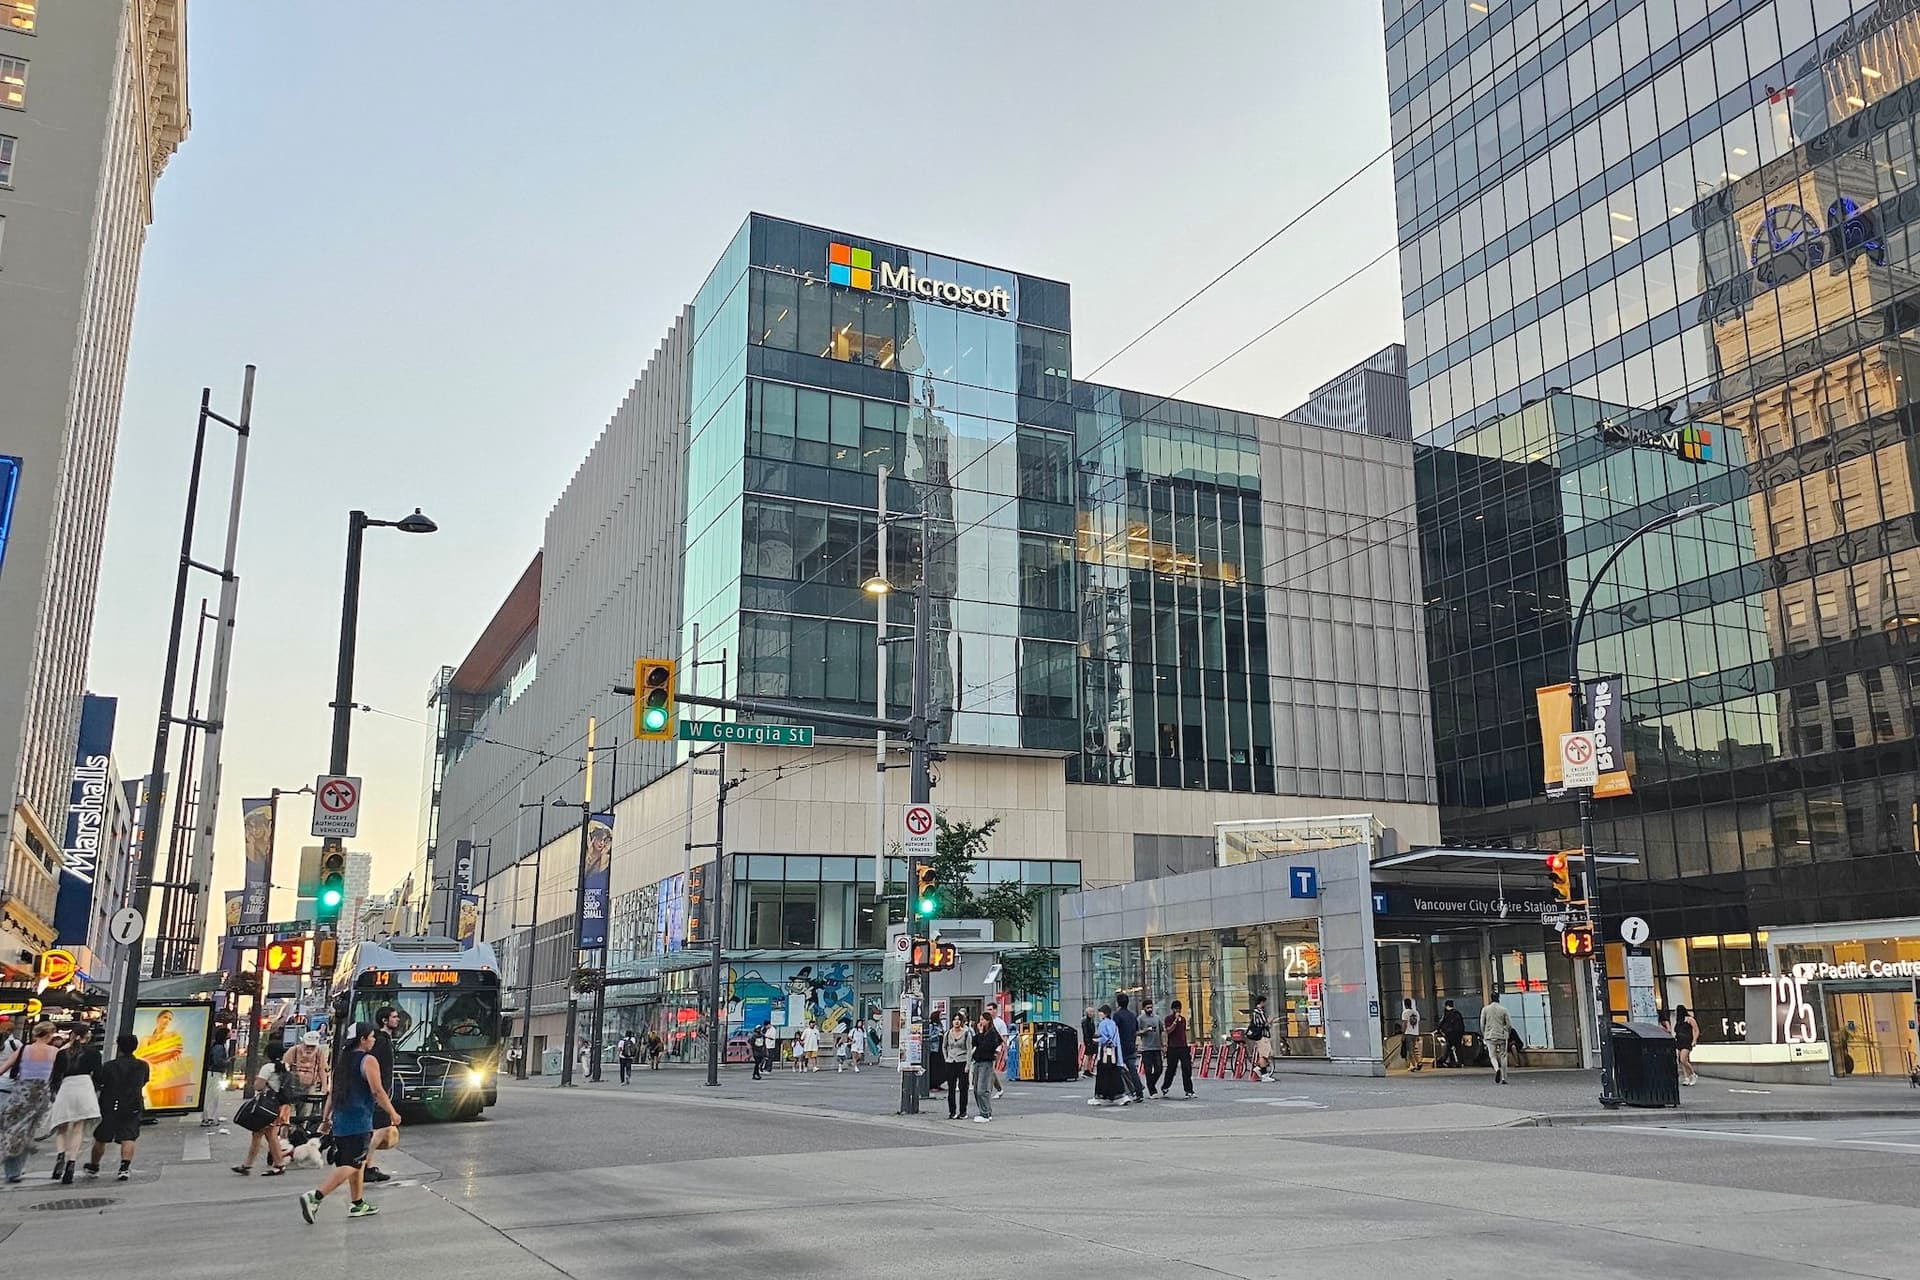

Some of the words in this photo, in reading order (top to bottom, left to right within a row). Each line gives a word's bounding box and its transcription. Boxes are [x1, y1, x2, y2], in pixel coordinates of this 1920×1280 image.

[880, 261, 1010, 313] Microsoft
[690, 722, 703, 737] W
[713, 724, 780, 743] Georgia
[789, 728, 805, 742] St
[62, 755, 109, 884] Marshalls
[1296, 872, 1311, 893] T
[583, 901, 600, 910] SHOP
[1373, 895, 1384, 911] T
[1414, 898, 1467, 912] Vancouver
[1469, 899, 1488, 914] City
[1490, 899, 1522, 912] Cetre
[1524, 899, 1558, 912] Station
[583, 910, 604, 919] SMALL
[232, 926, 241, 935] W
[244, 924, 280, 935] Georgia
[1584, 934, 1592, 952] 3
[291, 946, 302, 967] 3
[946, 948, 954, 966] 3
[375, 971, 390, 985] 14
[411, 971, 459, 984] DOWNTOWN
[1819, 961, 1867, 980] Pacific
[1870, 959, 1920, 978] Centre
[1739, 976, 1818, 1044] 725
